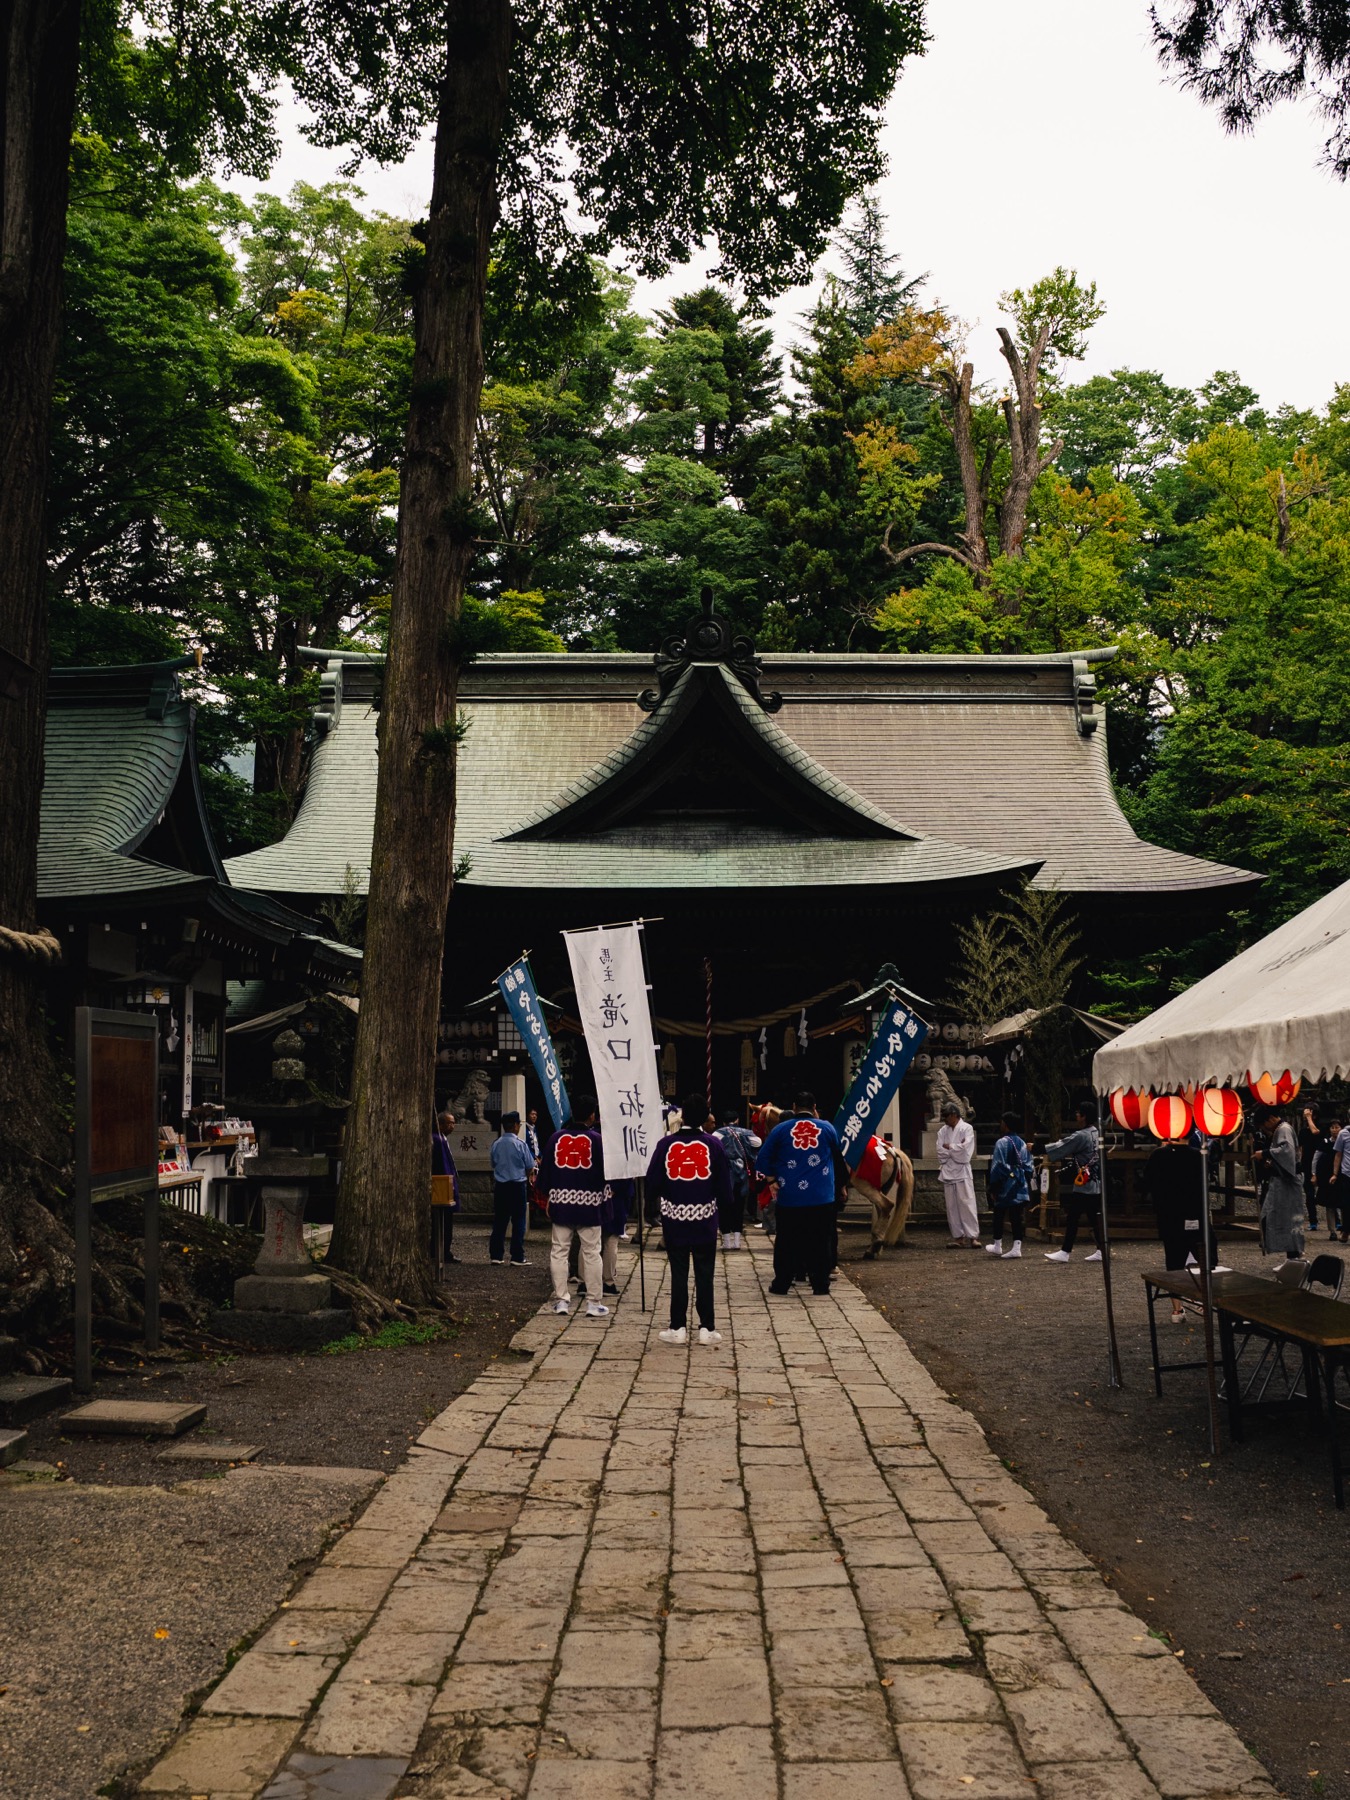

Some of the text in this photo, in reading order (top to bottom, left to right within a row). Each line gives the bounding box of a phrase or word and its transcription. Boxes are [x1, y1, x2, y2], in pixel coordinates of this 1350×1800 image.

[892, 1009, 918, 1039] 奉納
[554, 1134, 593, 1169] 祭
[789, 1118, 823, 1151] 祭
[665, 1139, 712, 1181] 祭
